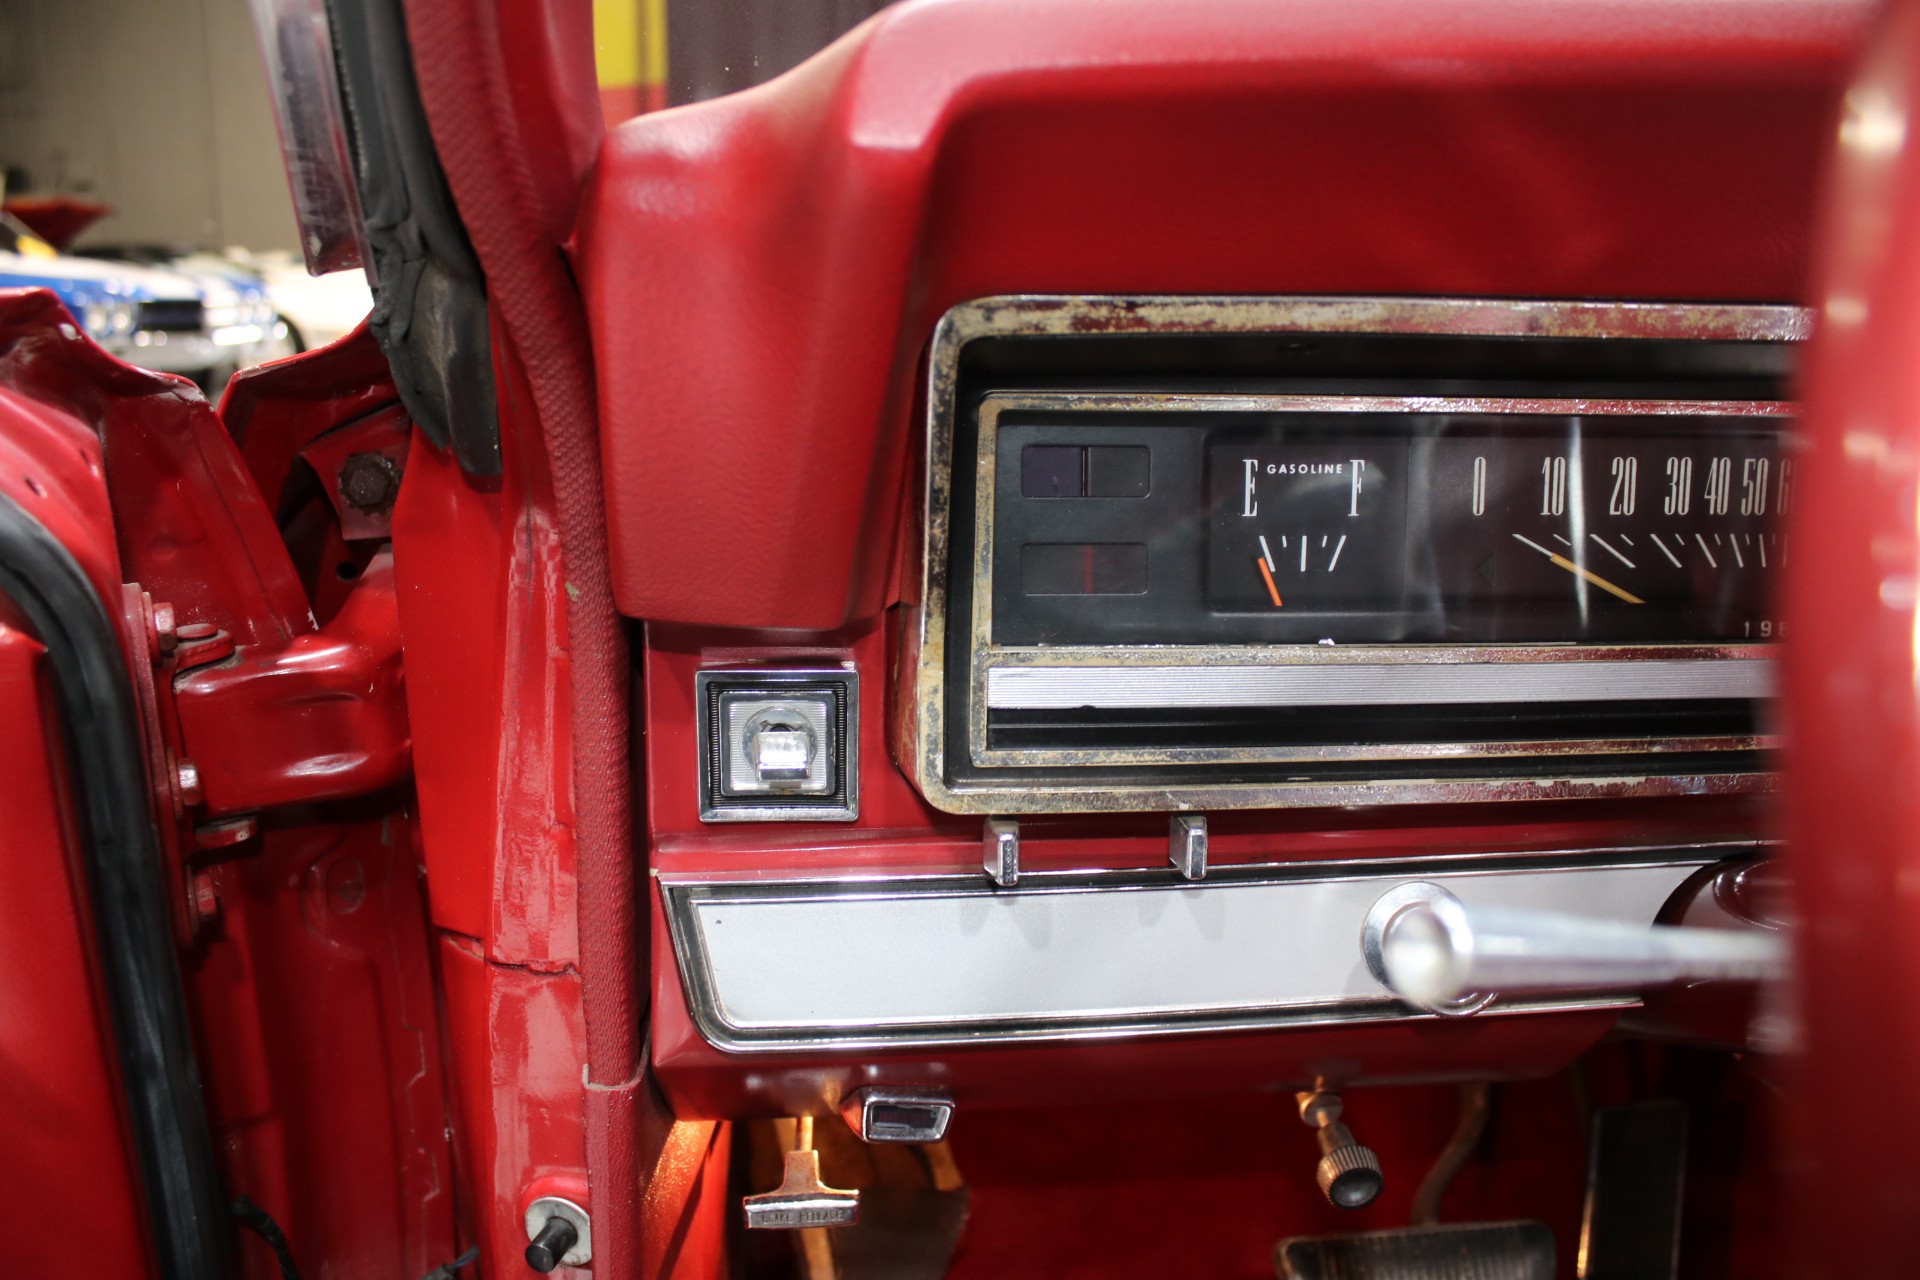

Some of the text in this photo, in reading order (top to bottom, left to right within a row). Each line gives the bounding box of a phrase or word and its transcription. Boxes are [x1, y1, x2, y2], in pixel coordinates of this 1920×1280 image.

[1241, 459, 1365, 517] E GASOLINE F
[1472, 456, 1486, 516] 0
[1540, 456, 1566, 516] 10
[1609, 456, 1638, 517] 20
[1664, 456, 1693, 516] 30
[1704, 457, 1731, 516] 40
[1741, 457, 1769, 516] 50
[761, 1209, 844, 1225] BRAKE RELEASE
